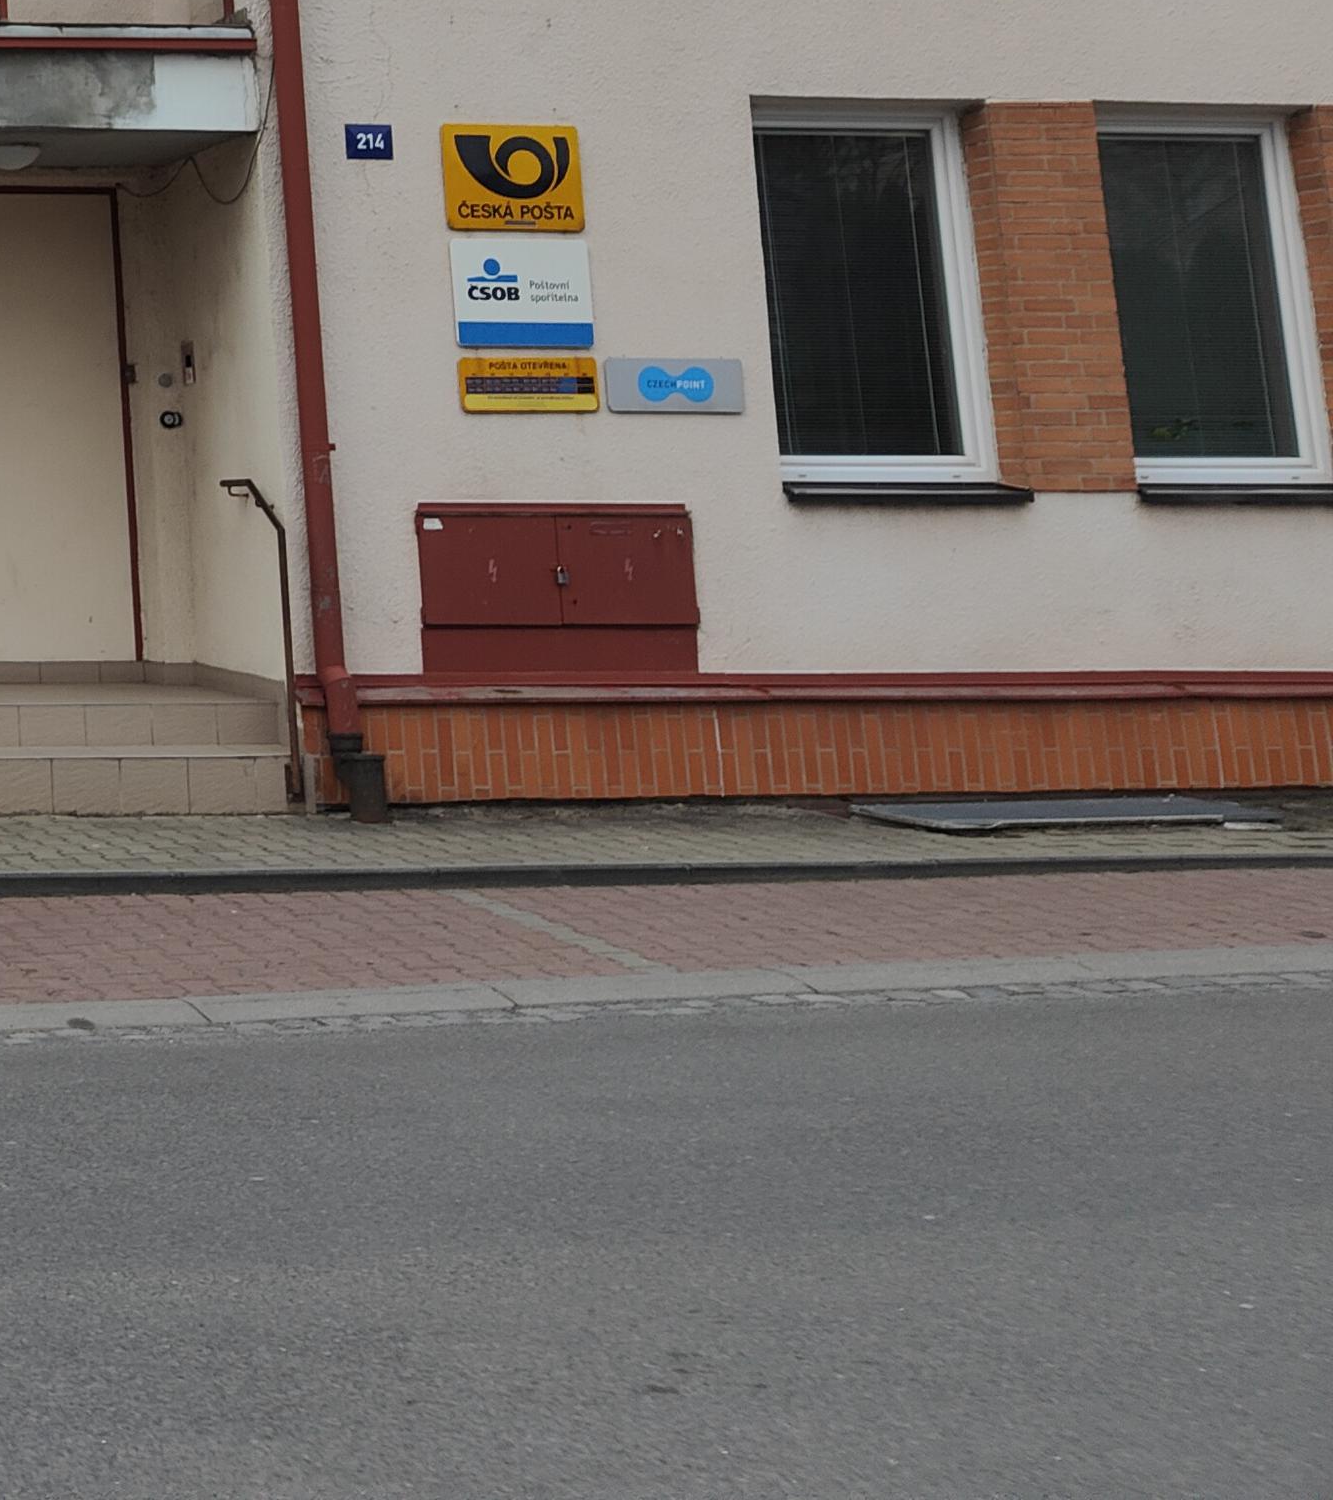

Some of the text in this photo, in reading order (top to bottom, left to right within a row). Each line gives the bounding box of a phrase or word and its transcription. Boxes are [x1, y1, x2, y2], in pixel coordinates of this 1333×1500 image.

[356, 132, 385, 150] 214
[458, 200, 574, 220] ČESKÁ POŠTA
[529, 280, 570, 290] Poštovní
[468, 284, 520, 301] ČSOB
[531, 293, 579, 304] spořitelna
[489, 360, 518, 370] POŠTA
